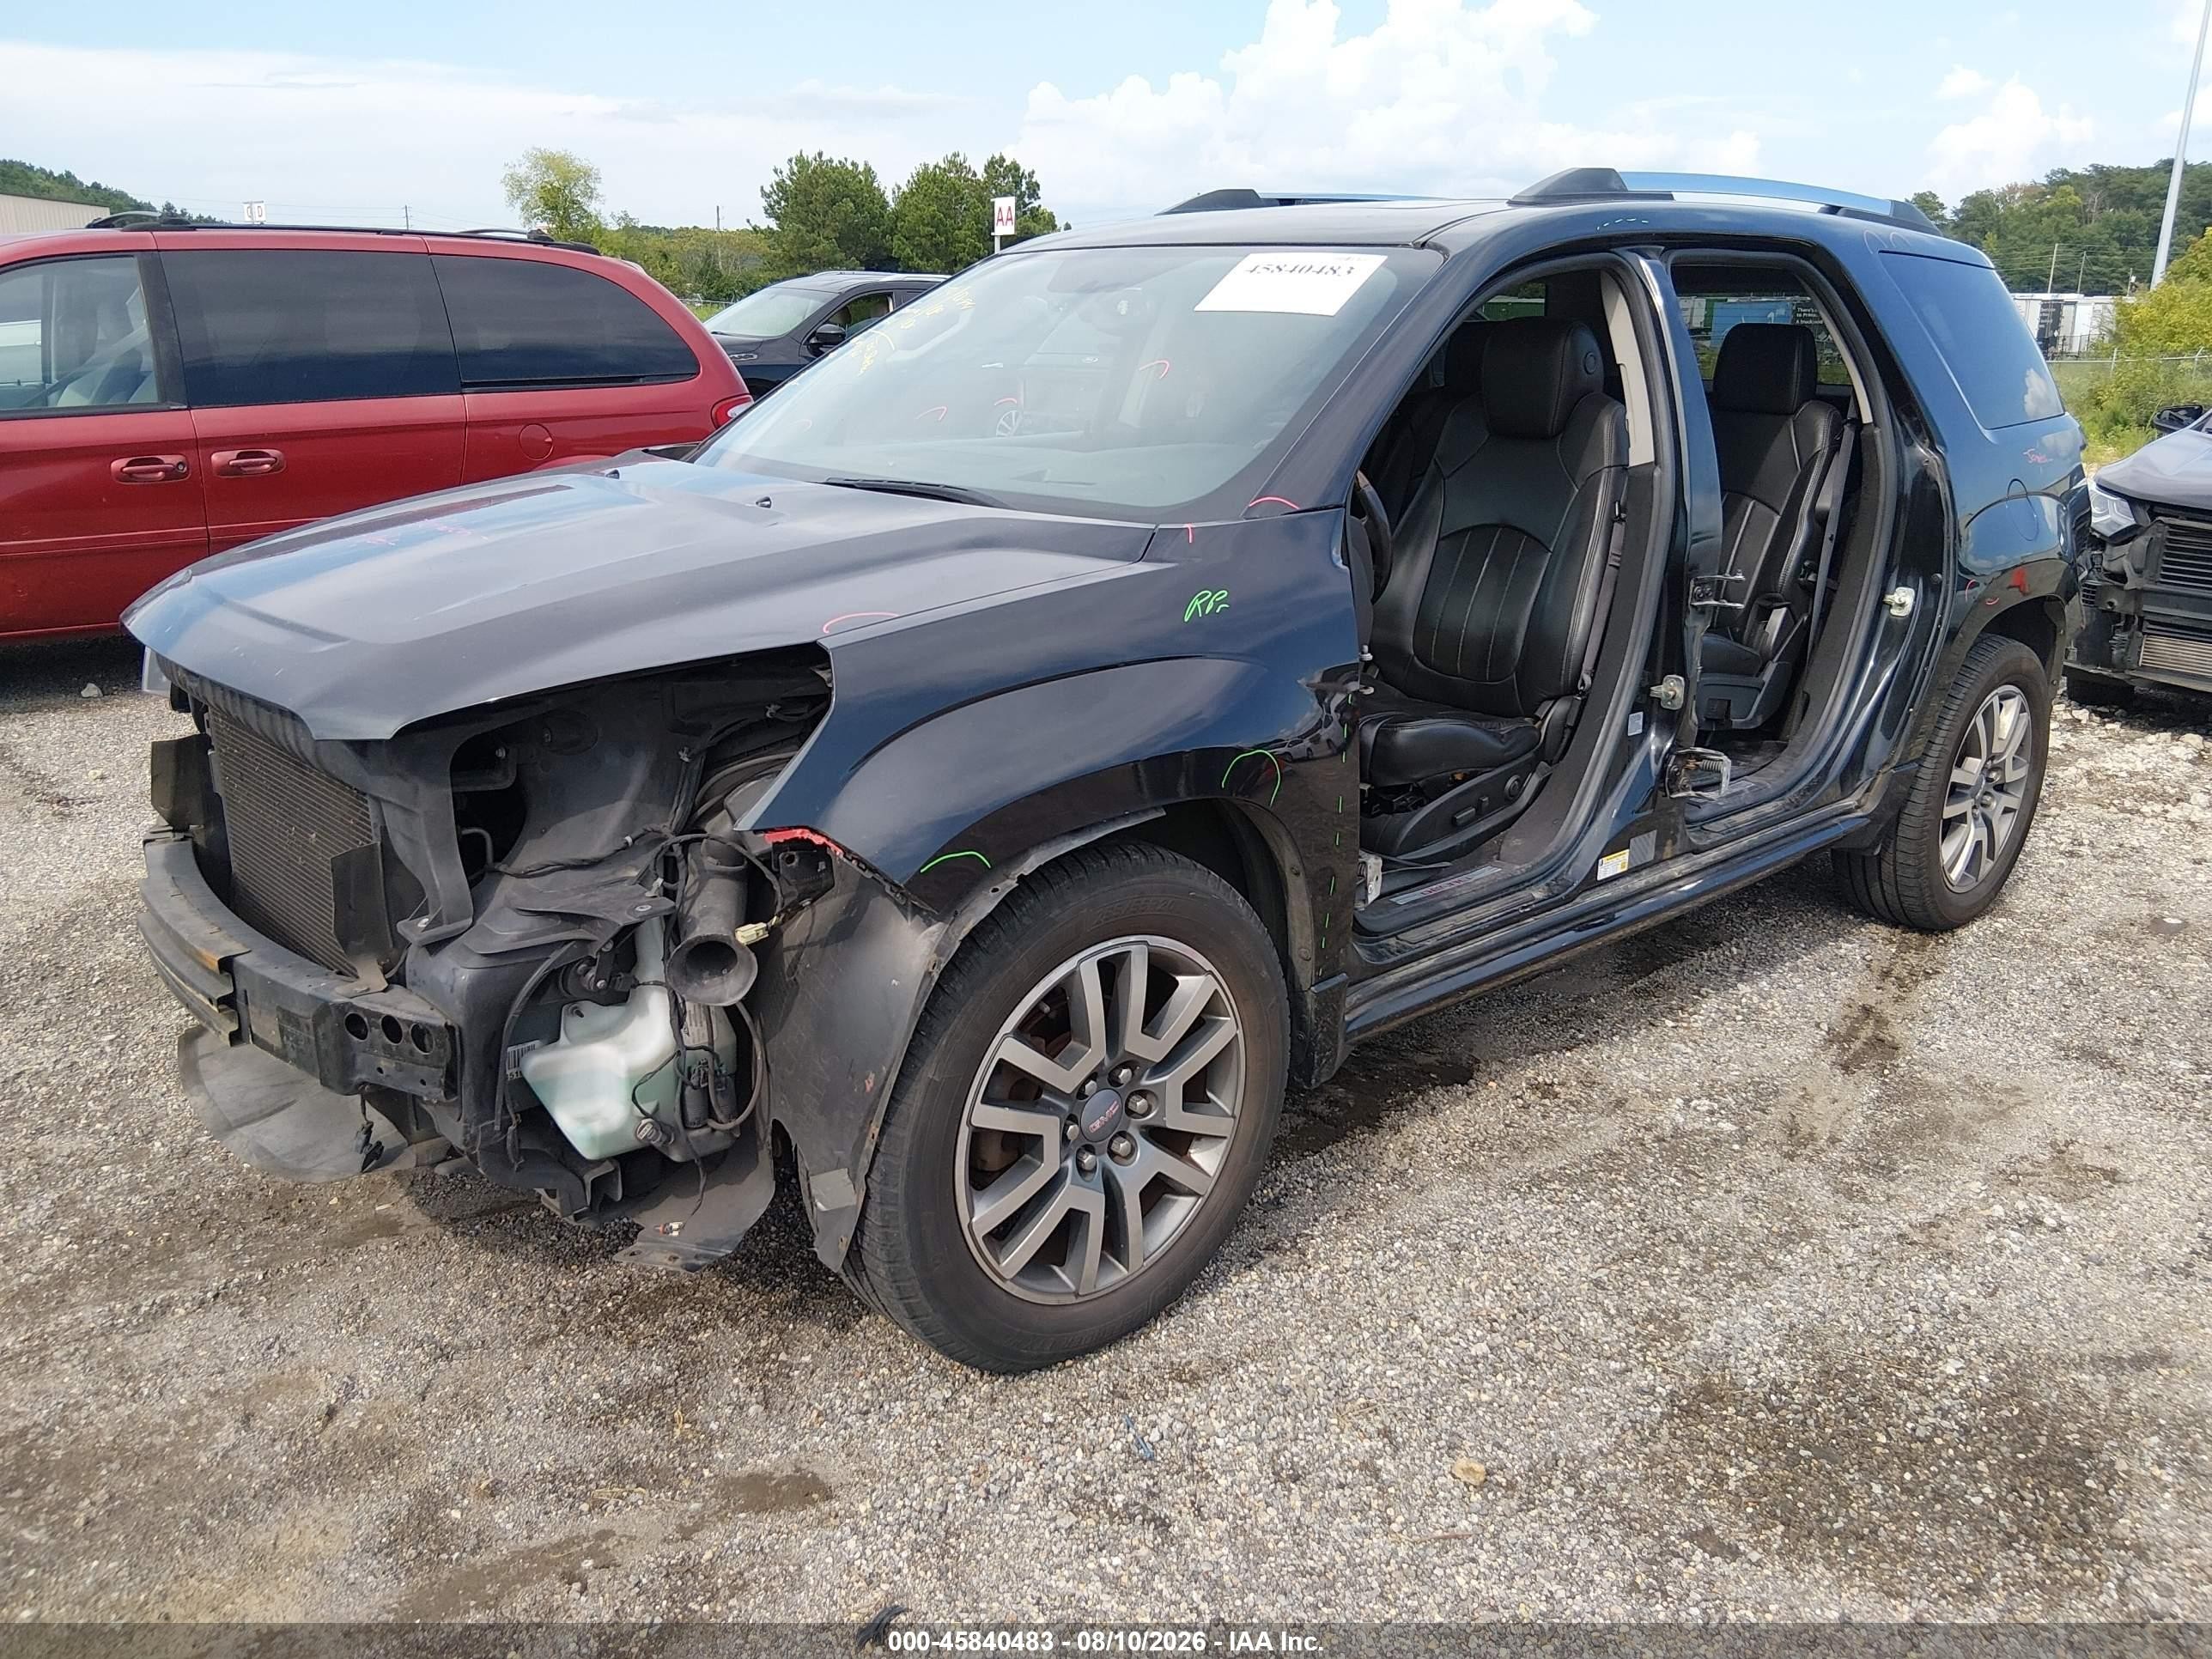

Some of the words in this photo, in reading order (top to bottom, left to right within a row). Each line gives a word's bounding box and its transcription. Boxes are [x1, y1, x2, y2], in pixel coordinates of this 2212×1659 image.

[996, 206, 1013, 226] AA
[1245, 264, 1355, 277] 45840483
[1089, 1100, 1120, 1133] GMC
